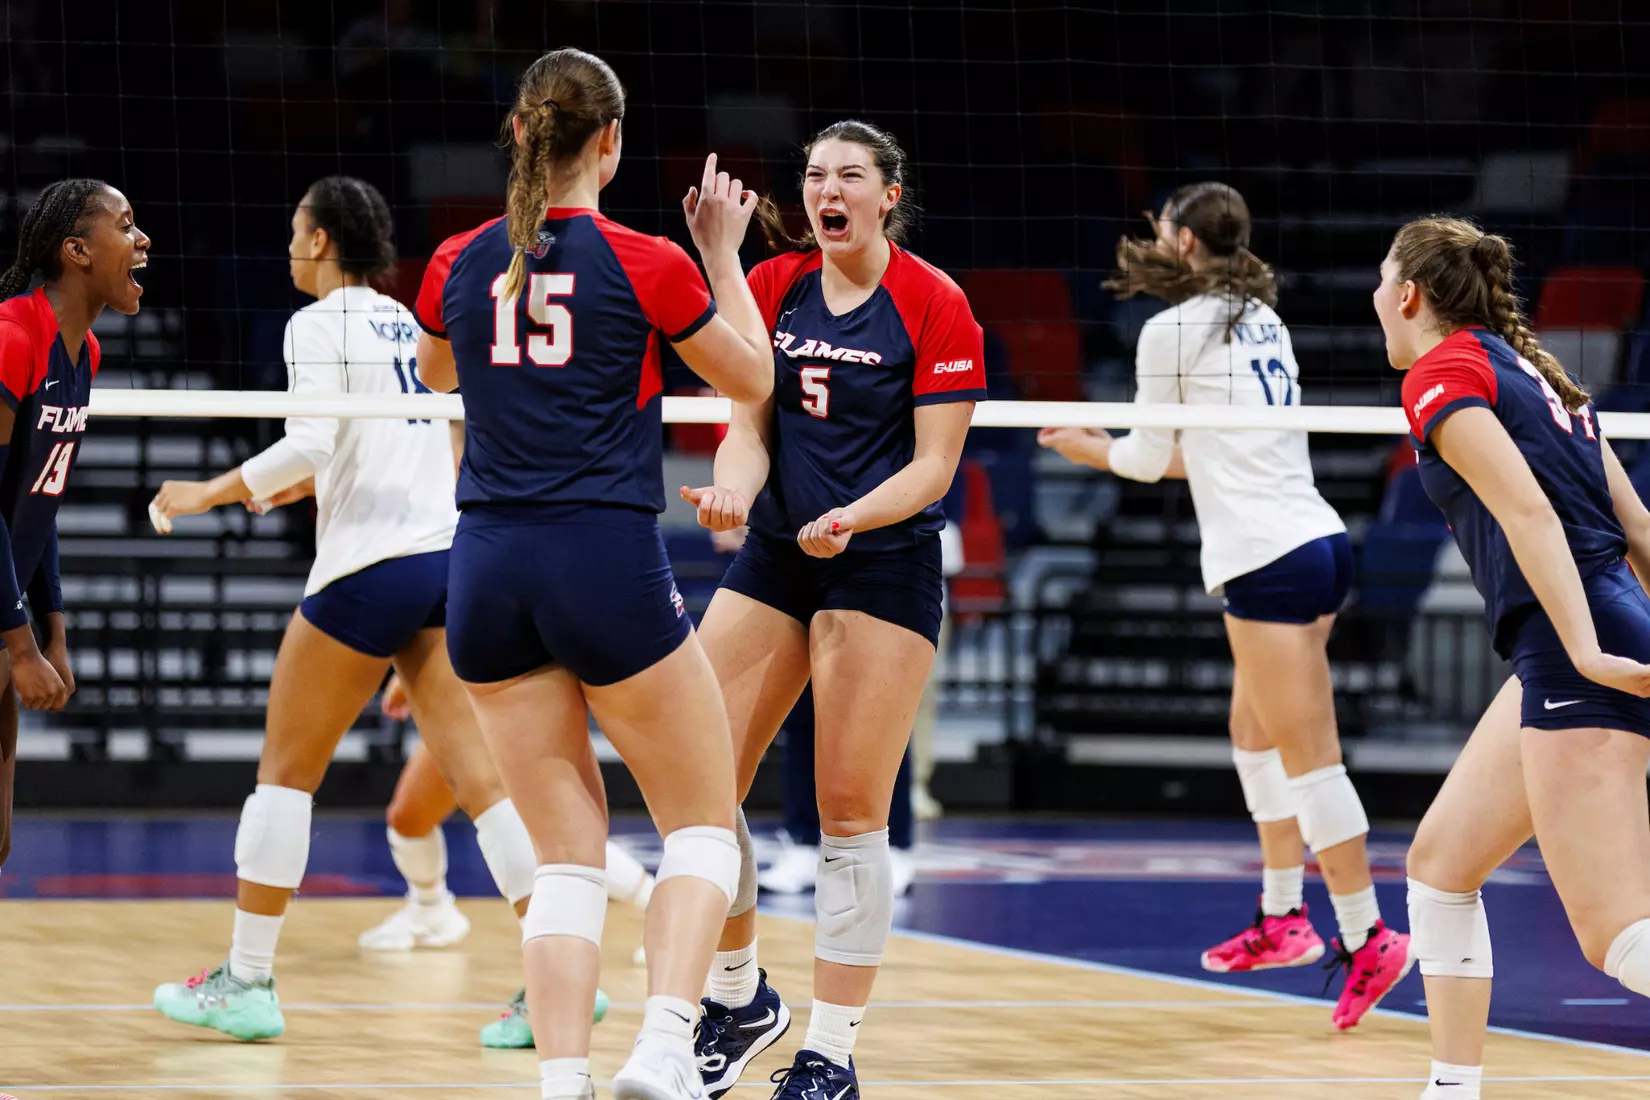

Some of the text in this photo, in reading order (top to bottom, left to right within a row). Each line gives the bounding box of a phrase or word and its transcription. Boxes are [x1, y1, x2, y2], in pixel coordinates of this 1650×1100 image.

[489, 272, 576, 367] 15
[773, 330, 882, 366] FLAMES
[799, 365, 832, 419] 5
[29, 441, 76, 497] 19
